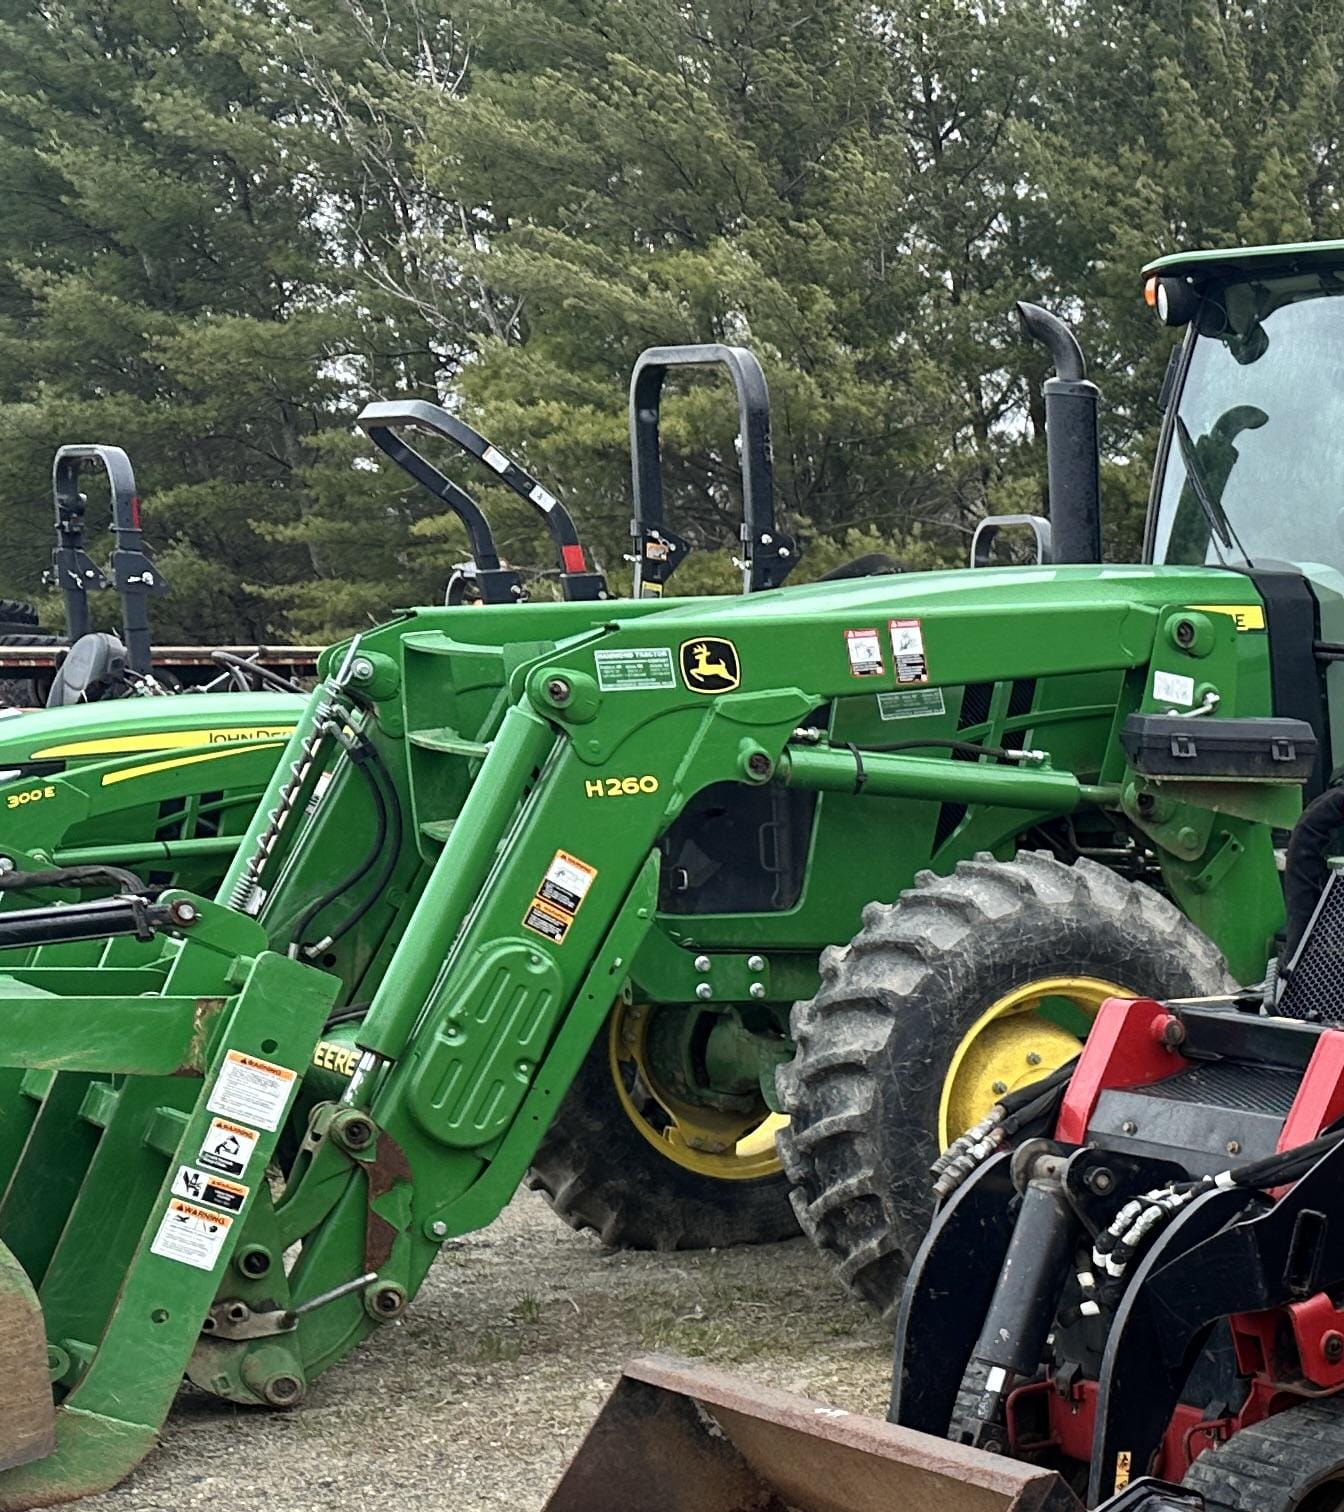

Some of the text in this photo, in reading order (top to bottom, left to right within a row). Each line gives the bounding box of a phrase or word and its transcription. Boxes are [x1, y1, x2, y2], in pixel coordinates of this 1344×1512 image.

[585, 775, 659, 798] H260
[313, 1040, 362, 1077] EERE
[184, 1203, 226, 1226] WARNING
